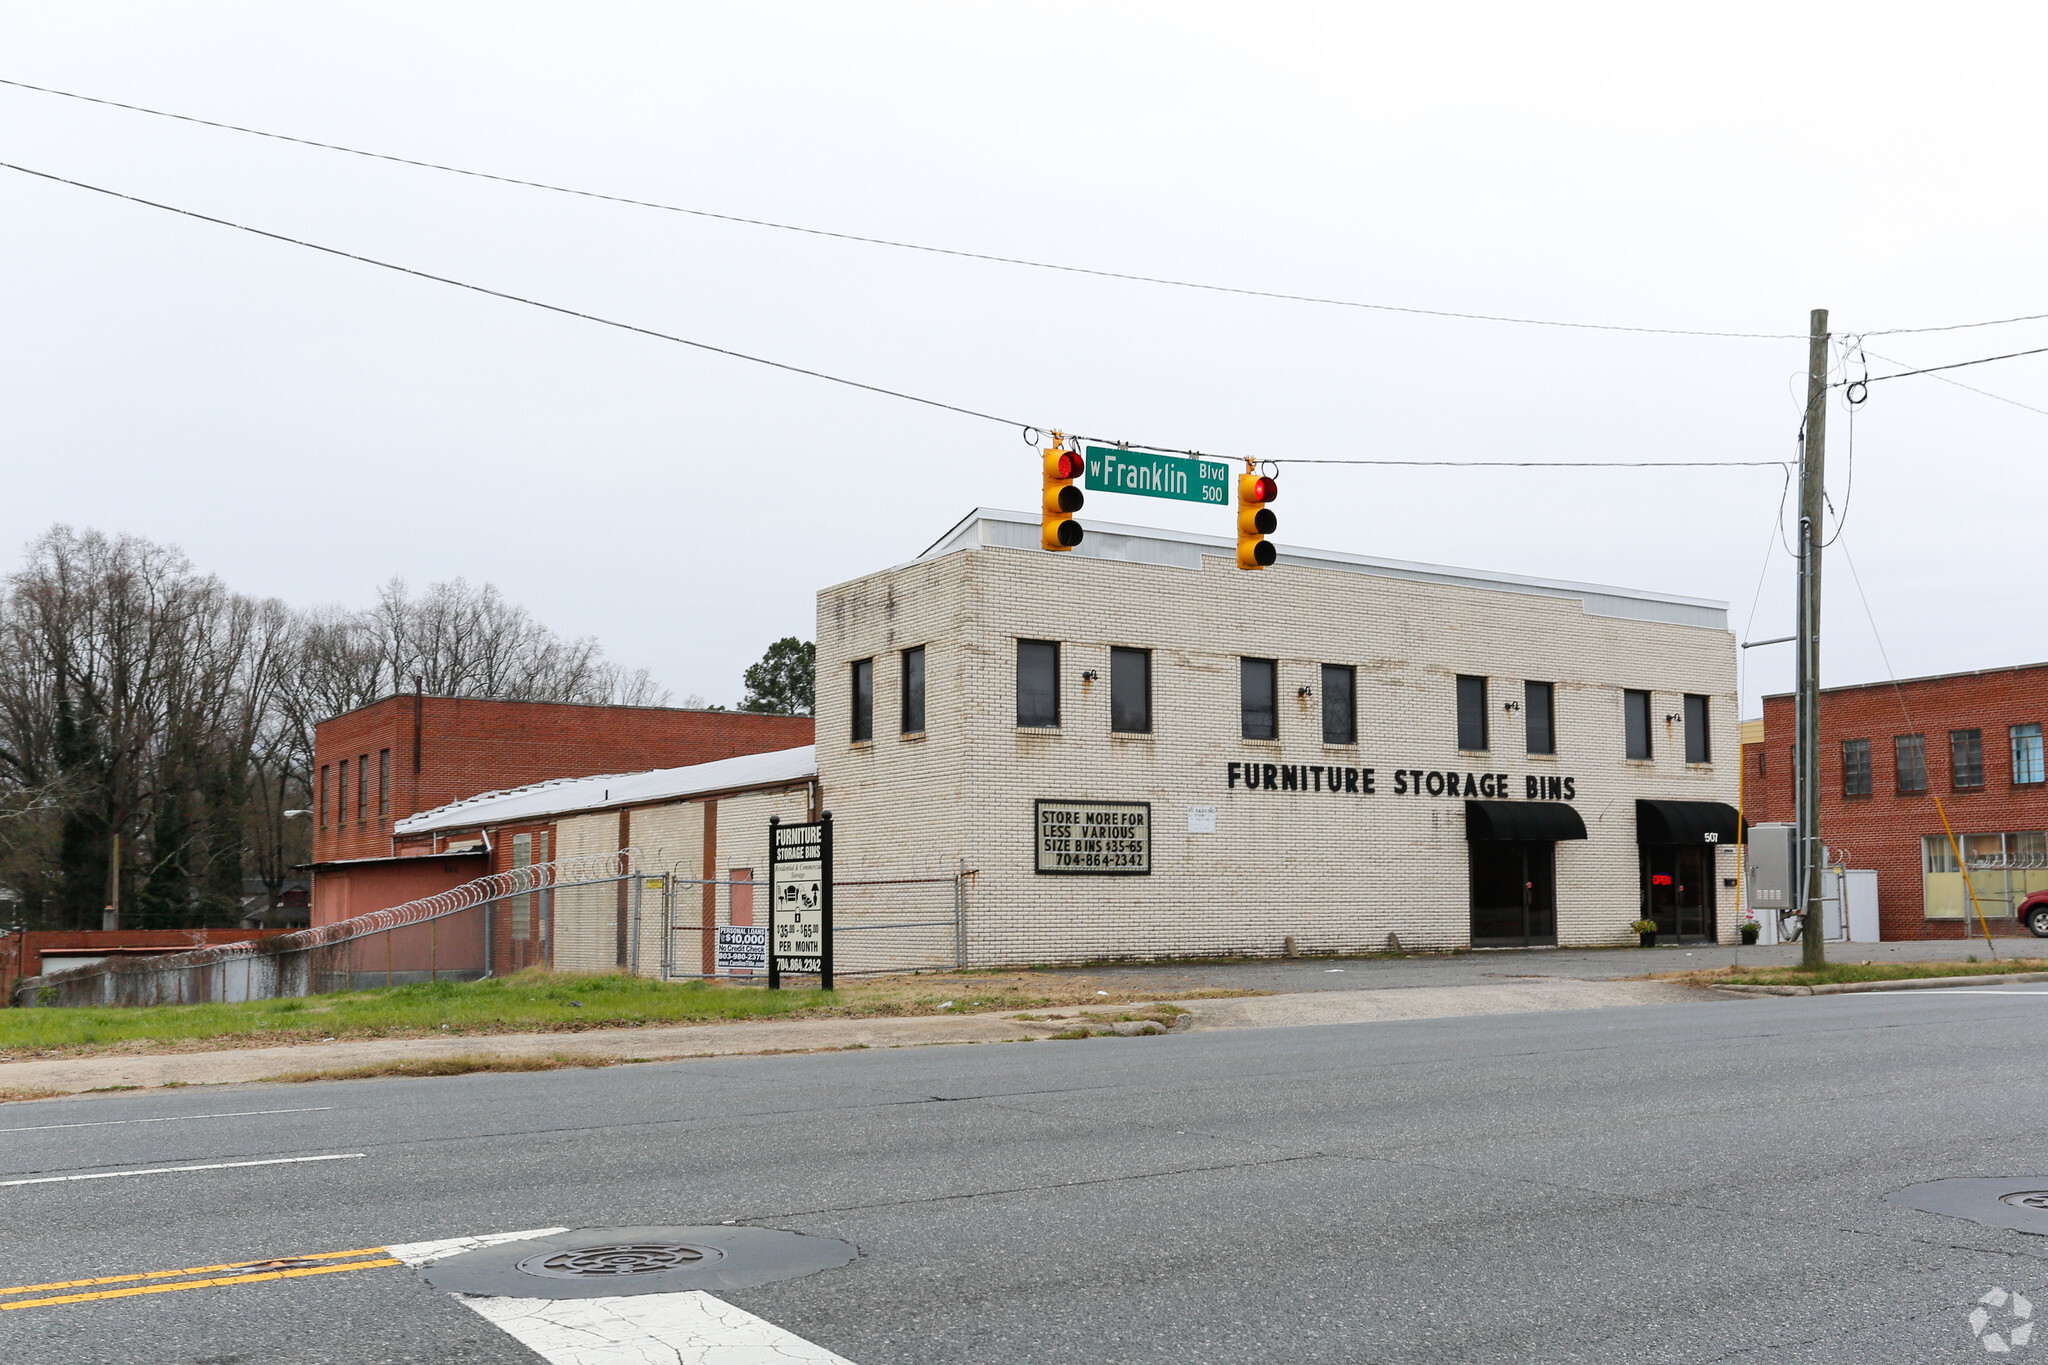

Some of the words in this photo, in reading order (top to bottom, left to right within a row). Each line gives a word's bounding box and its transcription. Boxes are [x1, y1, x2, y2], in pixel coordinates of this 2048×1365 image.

[1090, 460, 1101, 477] W
[1104, 455, 1187, 494] Franklin
[1199, 463, 1224, 481] Blvd
[1202, 485, 1222, 502] 500
[1227, 762, 1375, 793] FURNITURE
[1394, 769, 1509, 798] STORAGE
[1525, 775, 1576, 800] BINS
[1042, 810, 1080, 824] STORE
[1086, 812, 1118, 825] MORE
[1122, 813, 1144, 825] FOR
[776, 826, 822, 846] FURNITURE
[1043, 825, 1071, 838] LESS
[1082, 826, 1135, 839] VARIOUS
[1704, 832, 1718, 843] 507
[776, 846, 804, 861] STORAGE
[805, 845, 821, 859] BINS
[1044, 839, 1070, 852] SIZE
[1075, 839, 1102, 852] BINS
[1106, 840, 1142, 853] $35-65
[1056, 853, 1143, 867] 704-864-2342
[1652, 874, 1672, 885] OPEN
[725, 934, 764, 944] $10,000
[779, 940, 792, 952] PER
[795, 940, 818, 952] MONTH
[727, 944, 745, 952] Credit
[776, 958, 821, 972] 704.864.2342
